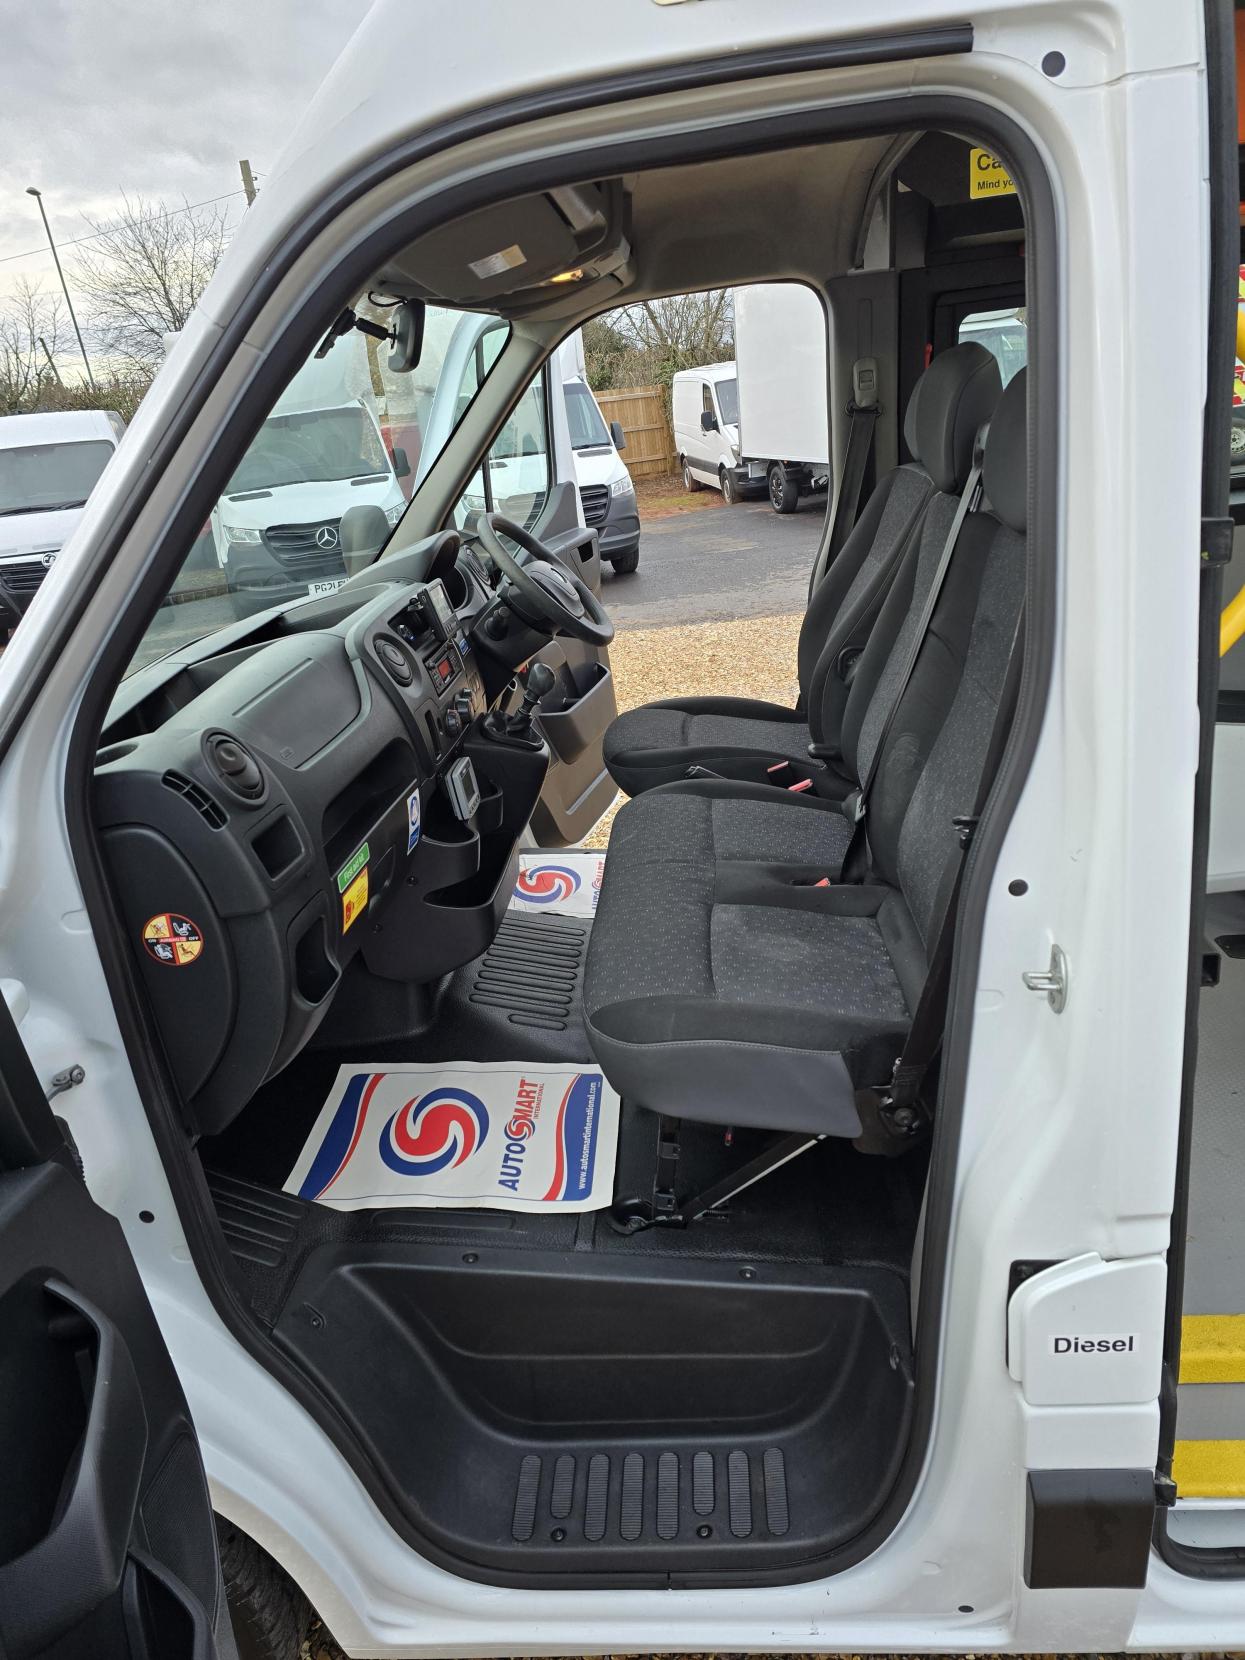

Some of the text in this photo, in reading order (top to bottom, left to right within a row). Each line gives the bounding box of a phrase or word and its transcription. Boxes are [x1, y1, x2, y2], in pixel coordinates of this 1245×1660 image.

[977, 180, 1000, 190] Mind
[533, 1083, 545, 1119] INTERNATIONAL
[498, 1078, 538, 1192] AUTOSMART
[579, 1082, 597, 1190] www.autosmartinternational.com
[1054, 1336, 1134, 1353] Diesel
